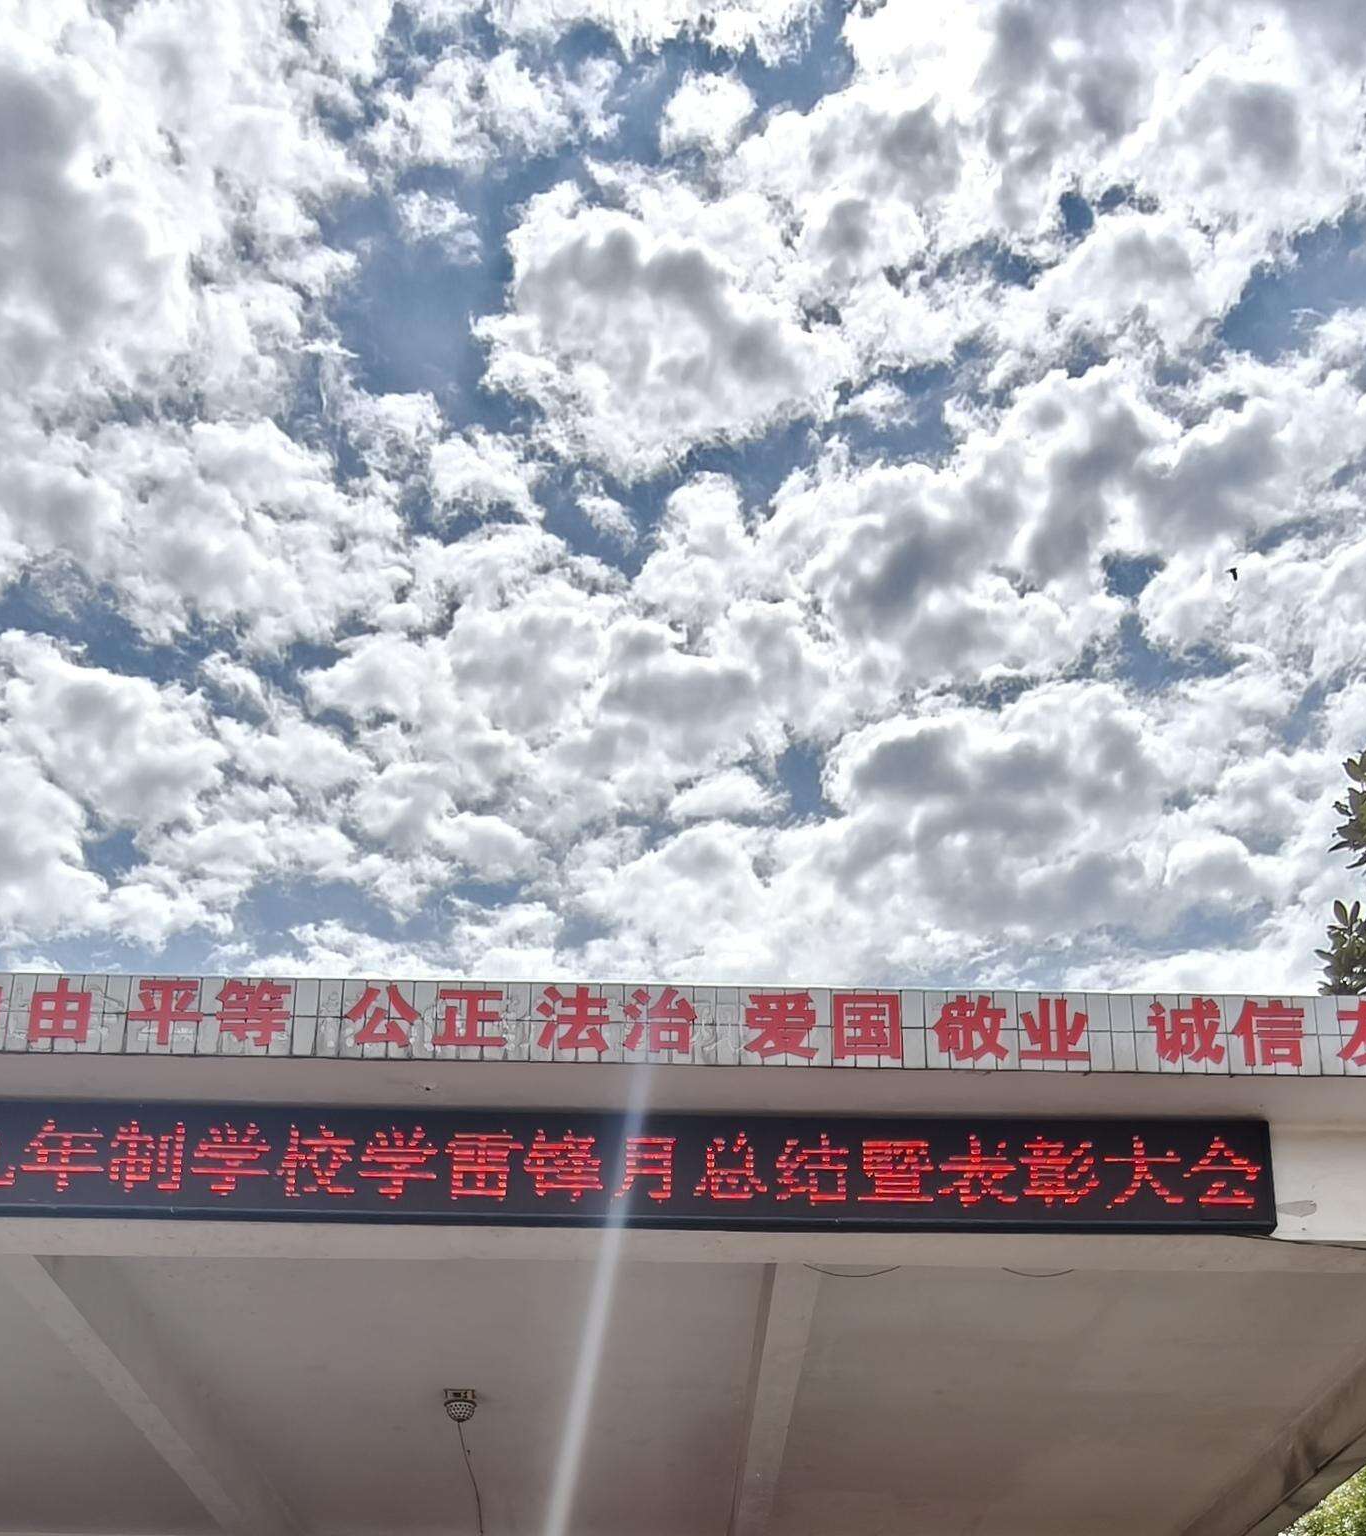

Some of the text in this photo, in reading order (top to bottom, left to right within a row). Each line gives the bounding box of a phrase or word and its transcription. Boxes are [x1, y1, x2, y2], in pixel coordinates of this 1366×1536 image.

[129, 981, 284, 1045] 平等
[351, 985, 503, 1047] 公正
[539, 988, 694, 1053] 法治
[746, 993, 903, 1060] 爱国
[934, 995, 1088, 1061] 敬业
[1150, 999, 1303, 1066] 诚信
